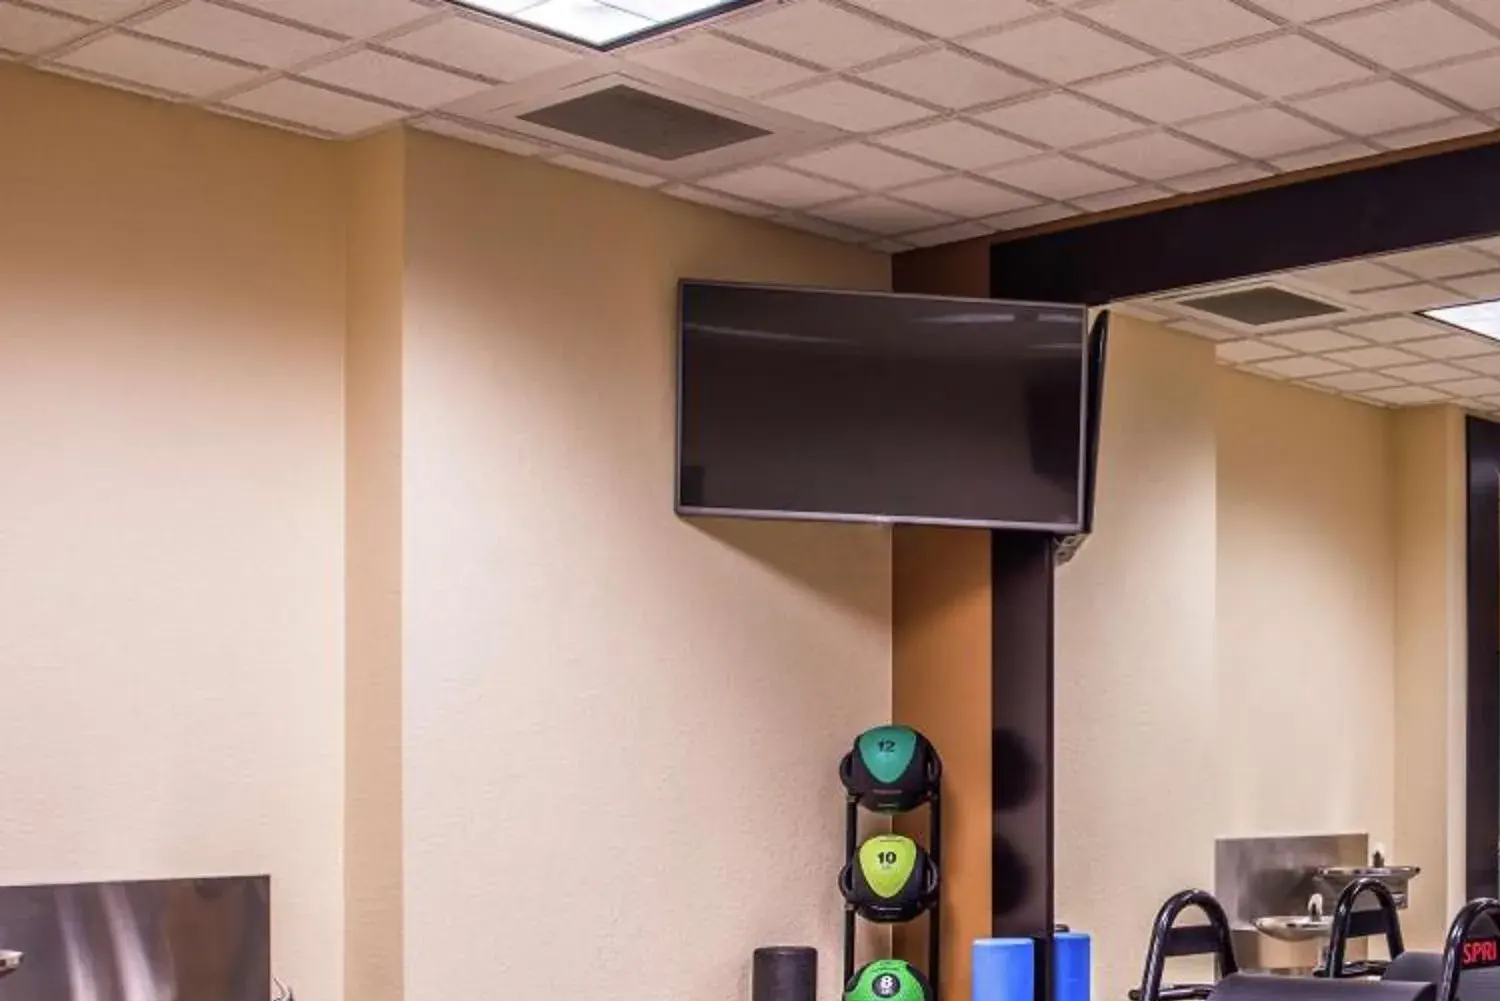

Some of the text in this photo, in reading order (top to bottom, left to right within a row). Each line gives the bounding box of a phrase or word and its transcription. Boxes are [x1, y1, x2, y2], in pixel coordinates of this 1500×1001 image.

[877, 740, 896, 753] 12
[877, 851, 897, 865] 10
[1463, 940, 1497, 964] SPRI
[880, 975, 893, 989] 8
